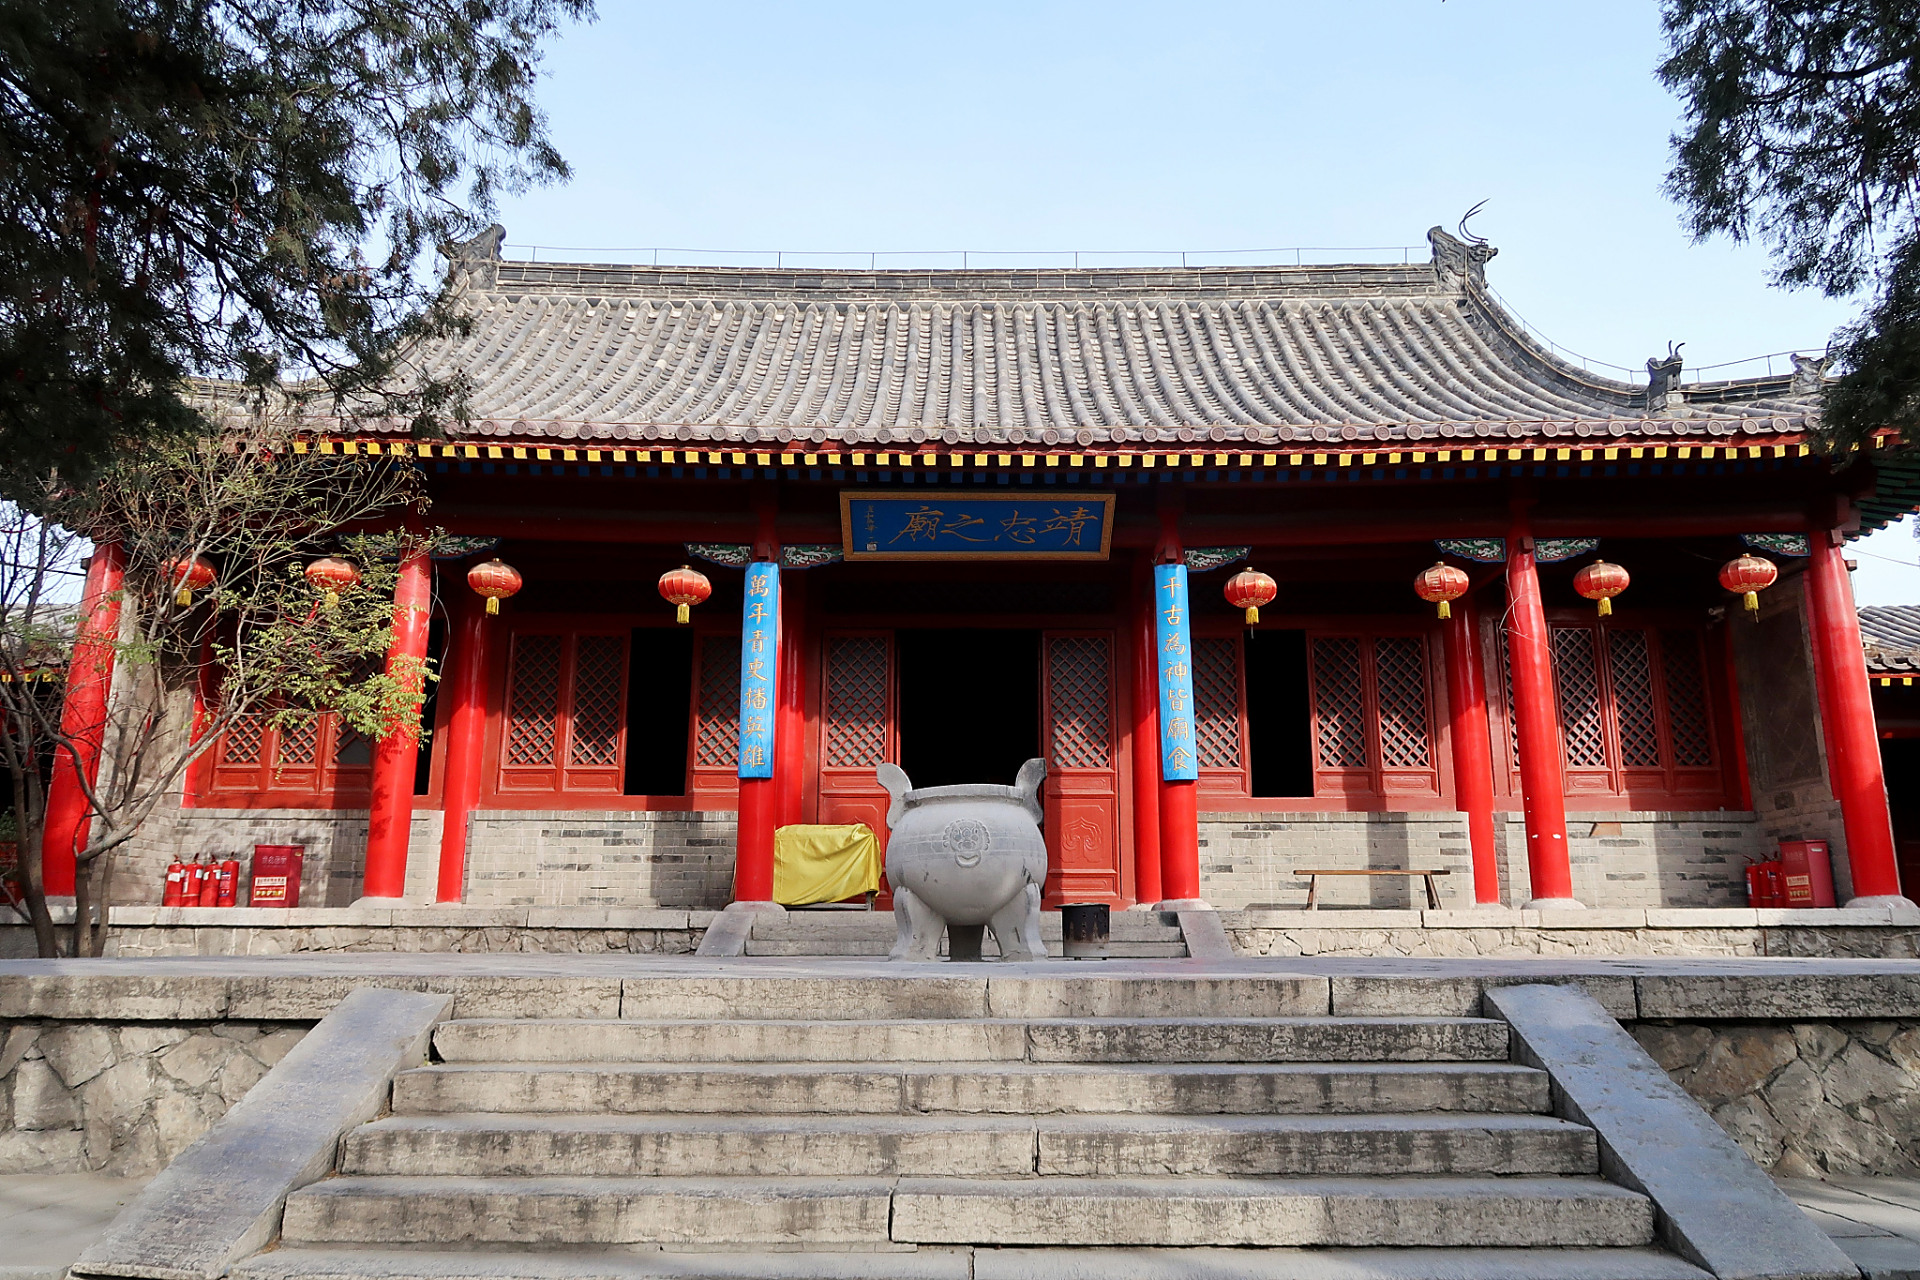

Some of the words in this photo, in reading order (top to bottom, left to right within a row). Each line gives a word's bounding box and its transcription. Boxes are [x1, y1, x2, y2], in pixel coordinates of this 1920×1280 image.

[742, 574, 769, 768] 萬年青史播英雄
